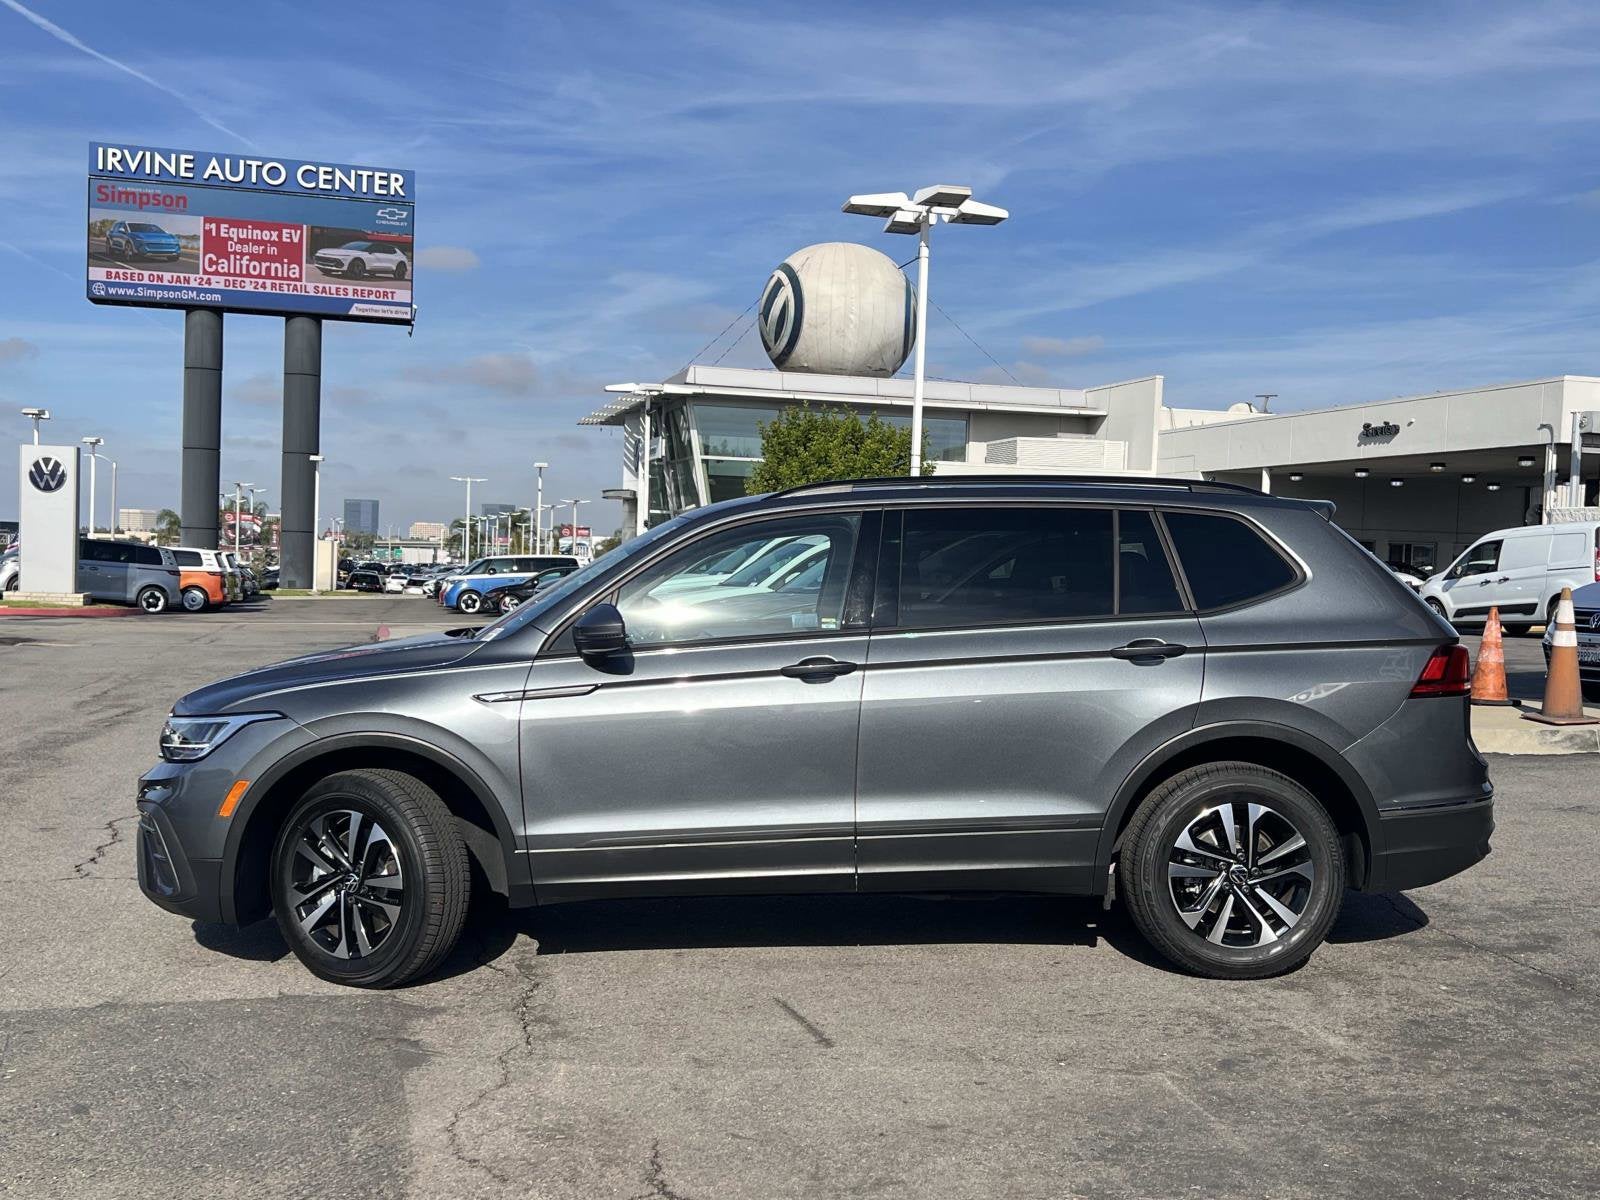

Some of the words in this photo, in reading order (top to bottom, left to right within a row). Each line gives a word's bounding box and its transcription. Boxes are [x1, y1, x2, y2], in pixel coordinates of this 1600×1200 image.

[97, 146, 195, 179] IRVINE
[202, 156, 287, 187] AUTO
[296, 164, 405, 197] CENTER
[96, 184, 188, 210] Simpson
[204, 222, 217, 237] #1
[220, 223, 279, 242] Equinox
[282, 228, 301, 243] EV
[227, 241, 265, 254] Dealer
[267, 243, 278, 256] in
[204, 253, 300, 278] California
[105, 270, 144, 282] BASED
[148, 273, 164, 283] ON
[167, 274, 191, 285] JAN
[223, 278, 246, 289] DEC
[270, 281, 310, 294] RETAIL
[313, 285, 349, 297] SALES
[352, 288, 397, 300] REPORT
[108, 285, 222, 302] www.SimpsonGM.com
